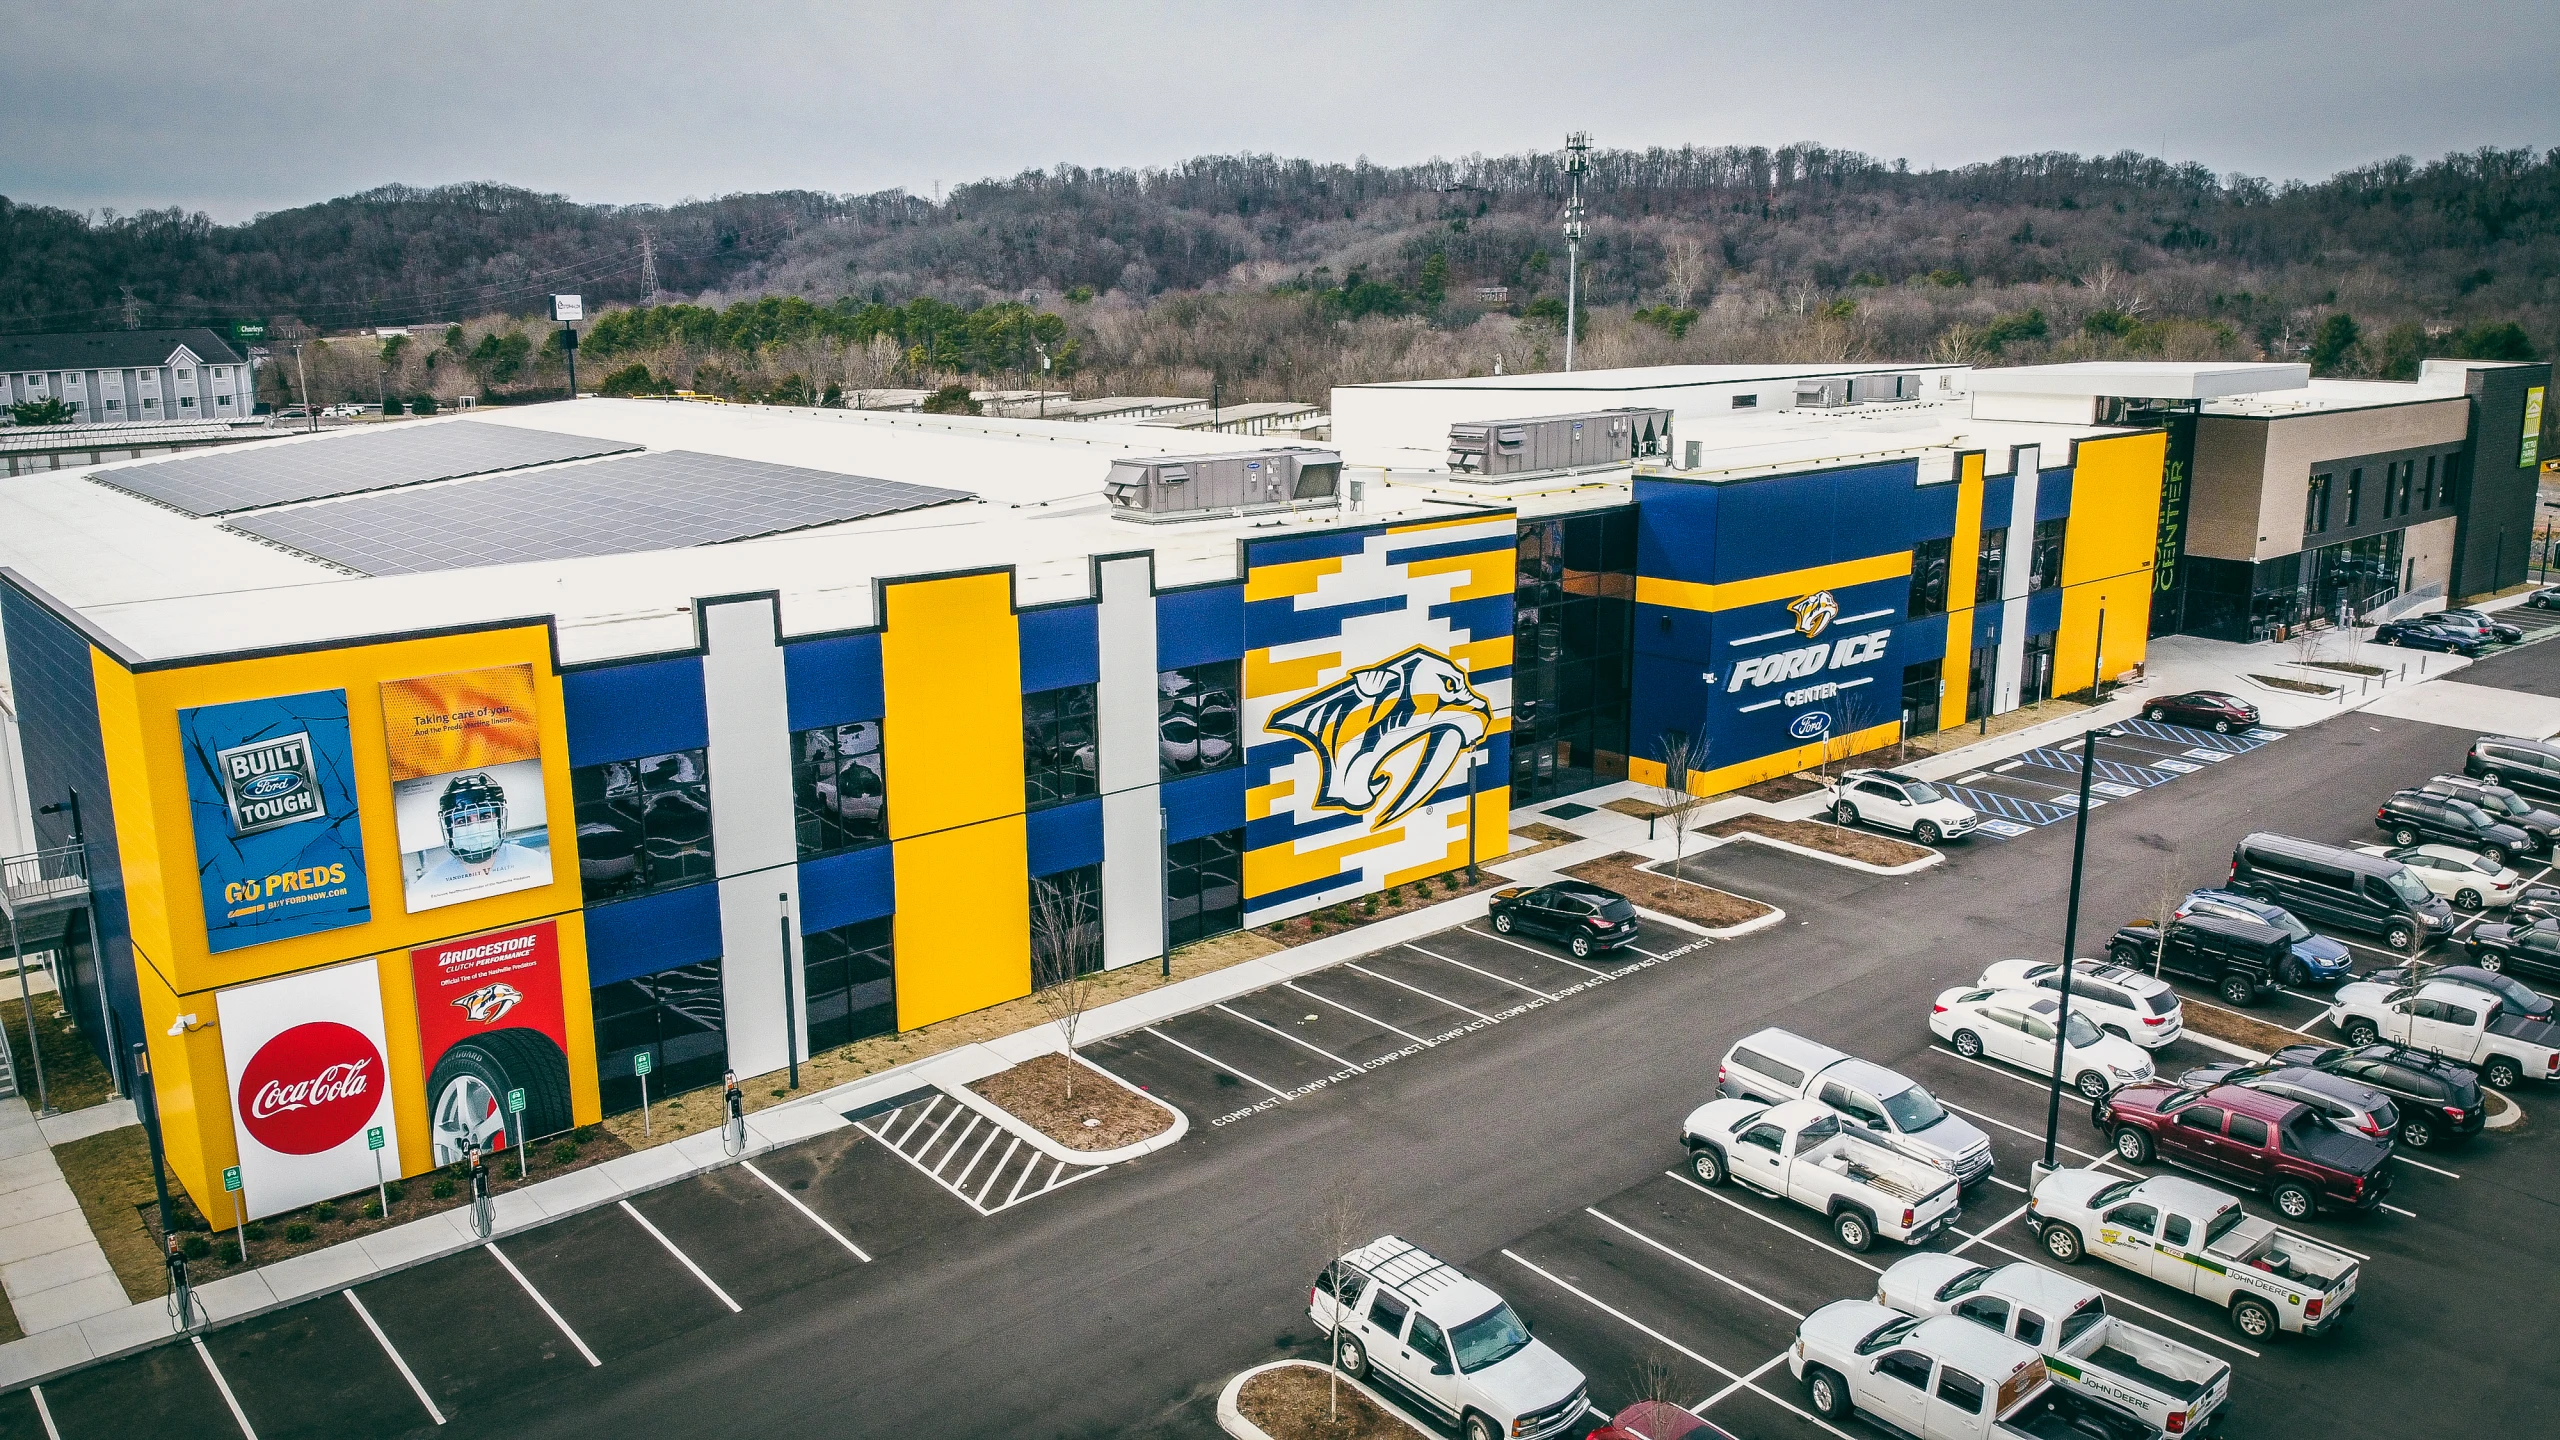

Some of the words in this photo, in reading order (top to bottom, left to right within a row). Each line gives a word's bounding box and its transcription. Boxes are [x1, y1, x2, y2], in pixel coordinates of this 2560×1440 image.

[2160, 461, 2184, 591] CENTER
[1727, 643, 1830, 693] FORD
[1828, 629, 1892, 670] ICE
[1784, 682, 1837, 708] CENTER
[414, 713, 449, 727] Taking
[452, 710, 475, 721] care
[477, 706, 488, 717] of
[490, 706, 512, 719] you.
[414, 727, 429, 736] And
[430, 725, 442, 734] the
[463, 719, 490, 729] starting
[1799, 716, 1823, 734] Ford
[230, 743, 301, 779] BUILT
[254, 777, 289, 795] Ford
[241, 791, 313, 823] TOUGH
[225, 880, 261, 904] GO
[265, 863, 347, 897] PREDS
[445, 871, 481, 882] VANDERBILT
[438, 934, 537, 967] BRIDGESTONE
[1662, 937, 1715, 962] COMPACT
[440, 976, 460, 987] Official
[461, 974, 471, 982] Tire
[471, 973, 478, 981] of
[478, 970, 488, 978] the
[488, 966, 512, 976] Nashville
[512, 960, 537, 971] Predators
[446, 961, 475, 974] CLUTCH
[1610, 957, 1662, 978] COMPACT
[1551, 975, 1610, 1000] COMPACT
[1494, 997, 1550, 1021] COMPACT
[1428, 1018, 1492, 1046] COMPACT
[1363, 1043, 1425, 1070] COMPACT
[251, 1057, 373, 1119] Coca-Cola
[1286, 1067, 1359, 1099] COMPACT
[1211, 1096, 1281, 1127] COMPACT
[2228, 1270, 2254, 1286] JOHN
[2255, 1280, 2288, 1298] DEERE
[2082, 1376, 2111, 1395] JOHN
[2113, 1388, 2150, 1411] DEERE
